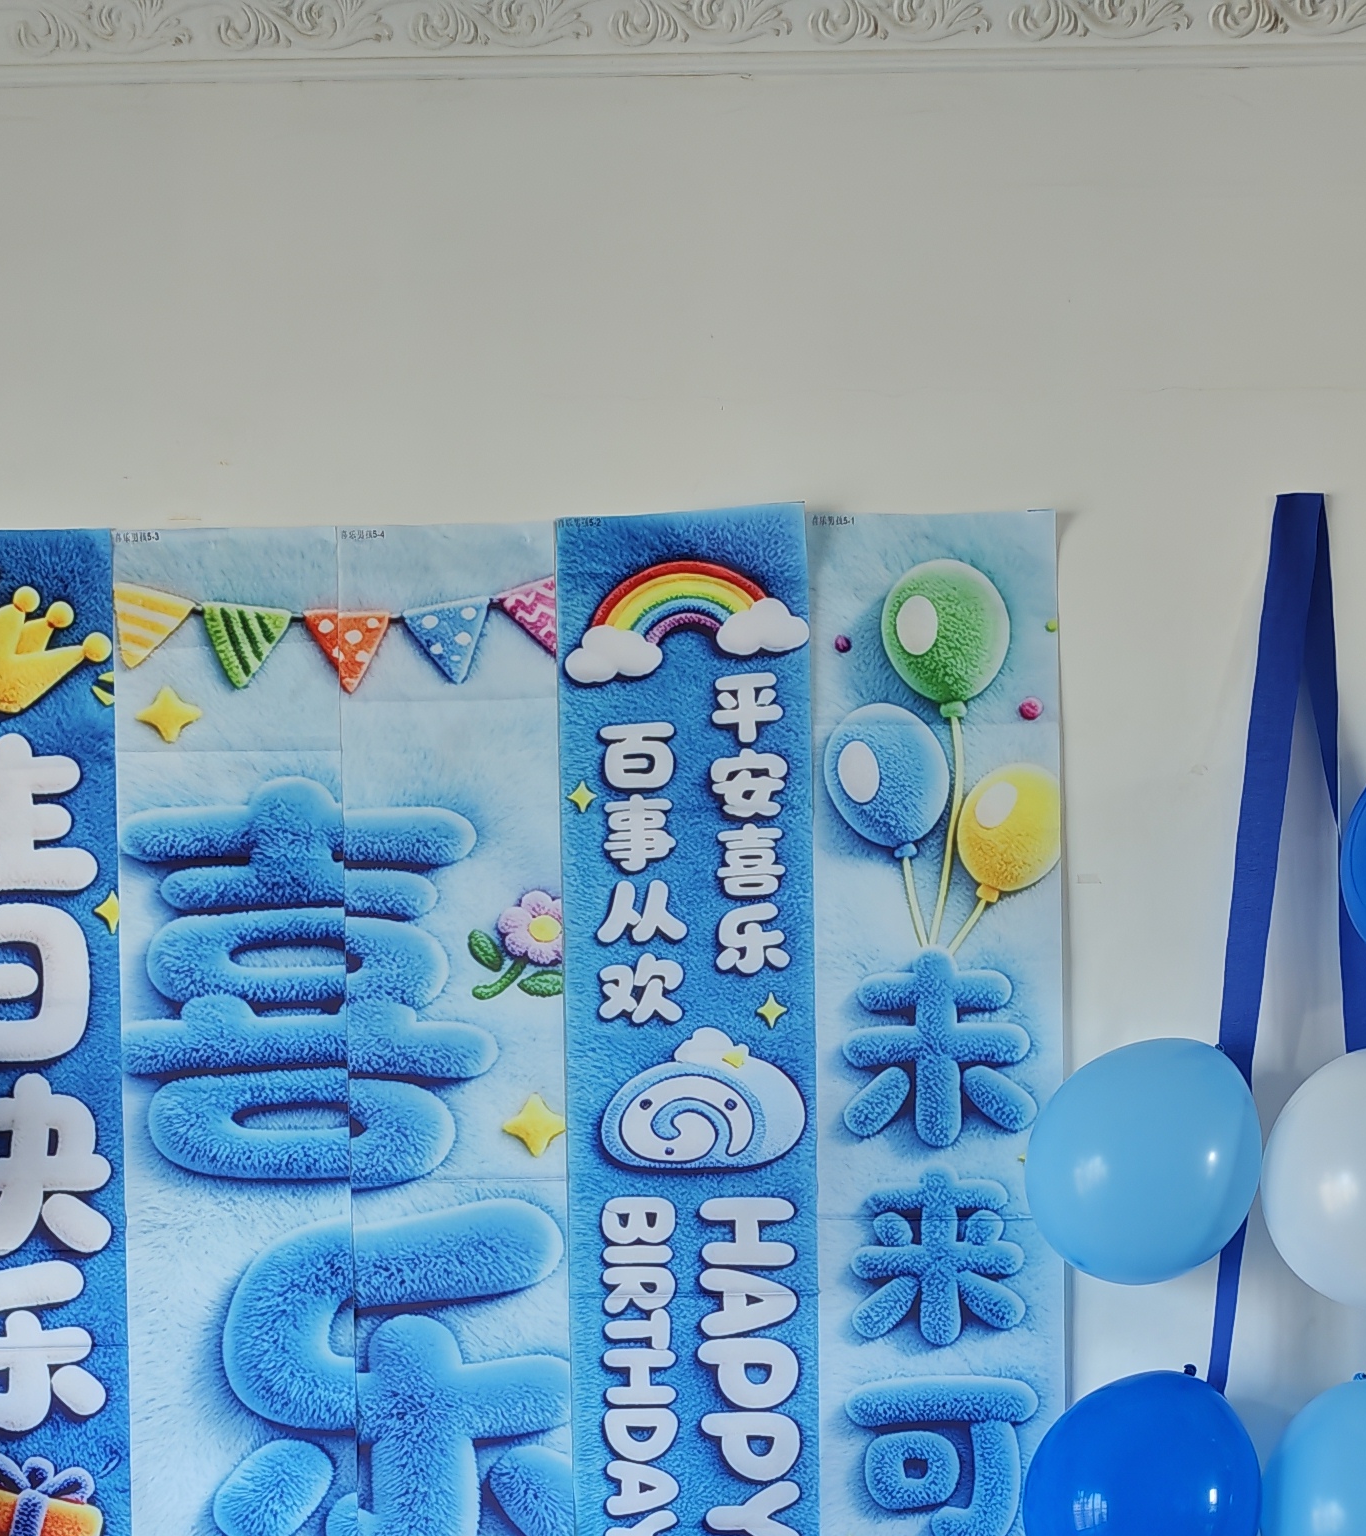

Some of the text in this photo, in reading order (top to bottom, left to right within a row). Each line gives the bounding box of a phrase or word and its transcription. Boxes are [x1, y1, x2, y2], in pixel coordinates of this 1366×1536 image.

[597, 722, 688, 1024] 百事从欢
[710, 672, 791, 974] 平安喜乐
